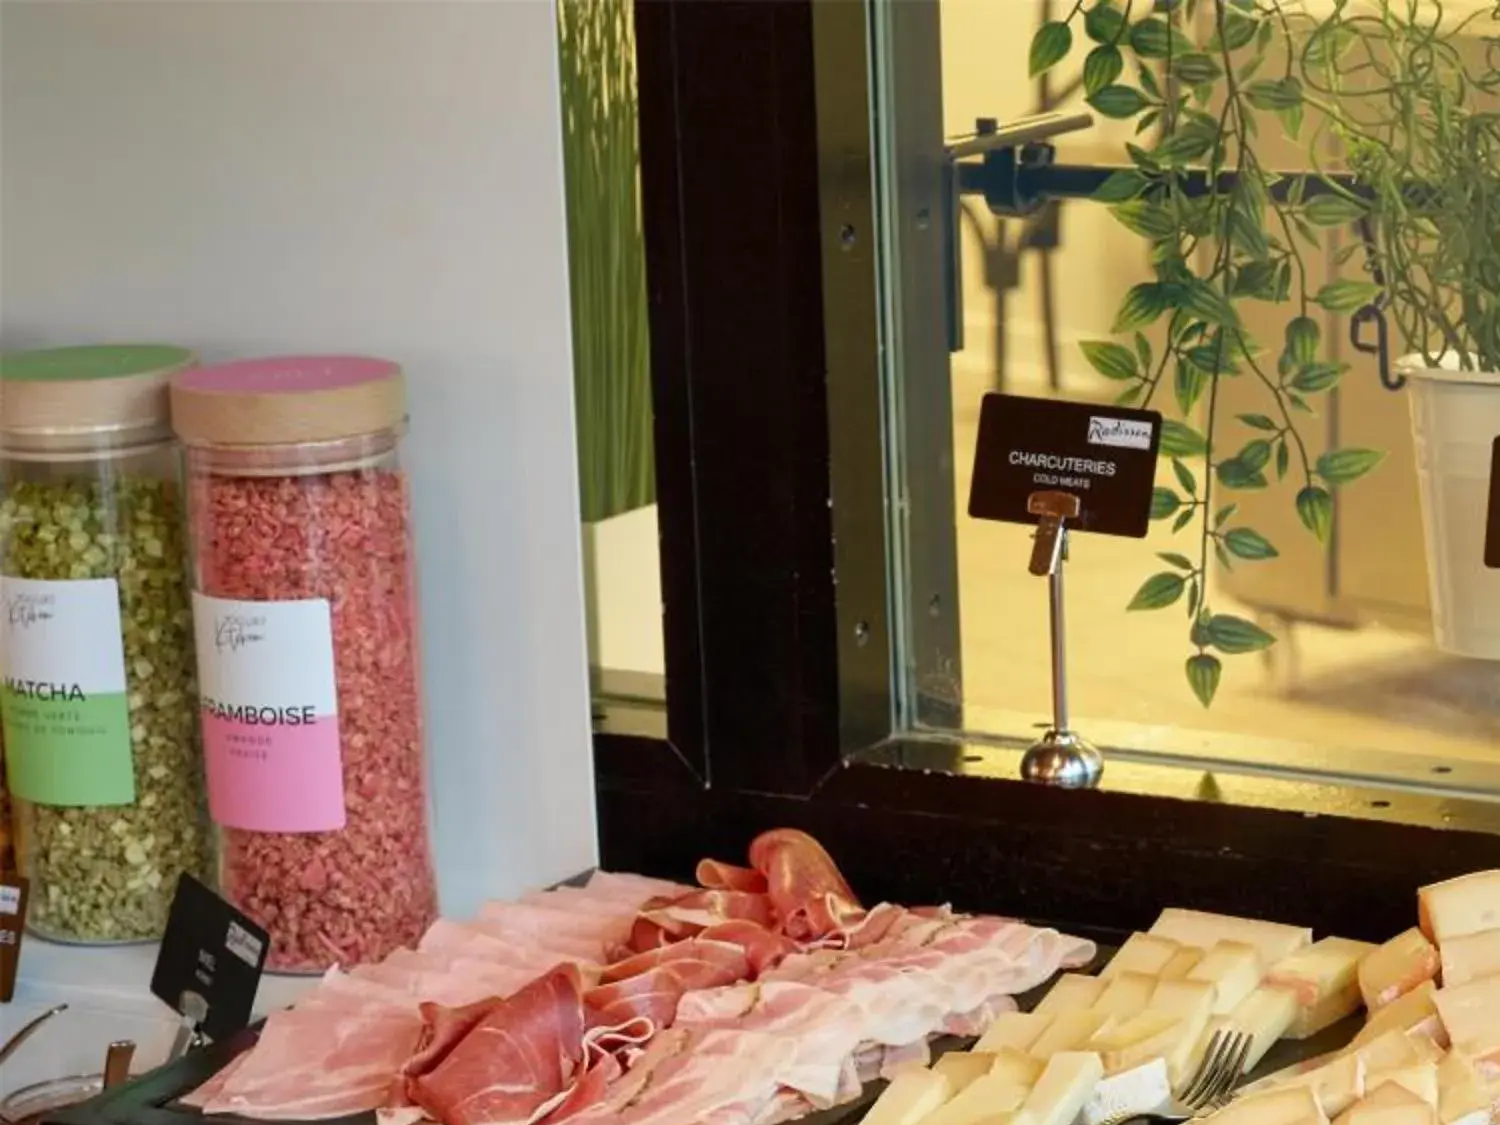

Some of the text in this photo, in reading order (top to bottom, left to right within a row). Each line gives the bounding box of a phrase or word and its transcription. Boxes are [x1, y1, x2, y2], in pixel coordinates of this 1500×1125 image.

[1090, 418, 1150, 441] Radisson
[1008, 451, 1117, 476] CHARCUTERIES
[1033, 473, 1091, 489] COLD MEATS
[4, 676, 86, 702] MATCHA
[201, 695, 317, 726] FRAMBOISE
